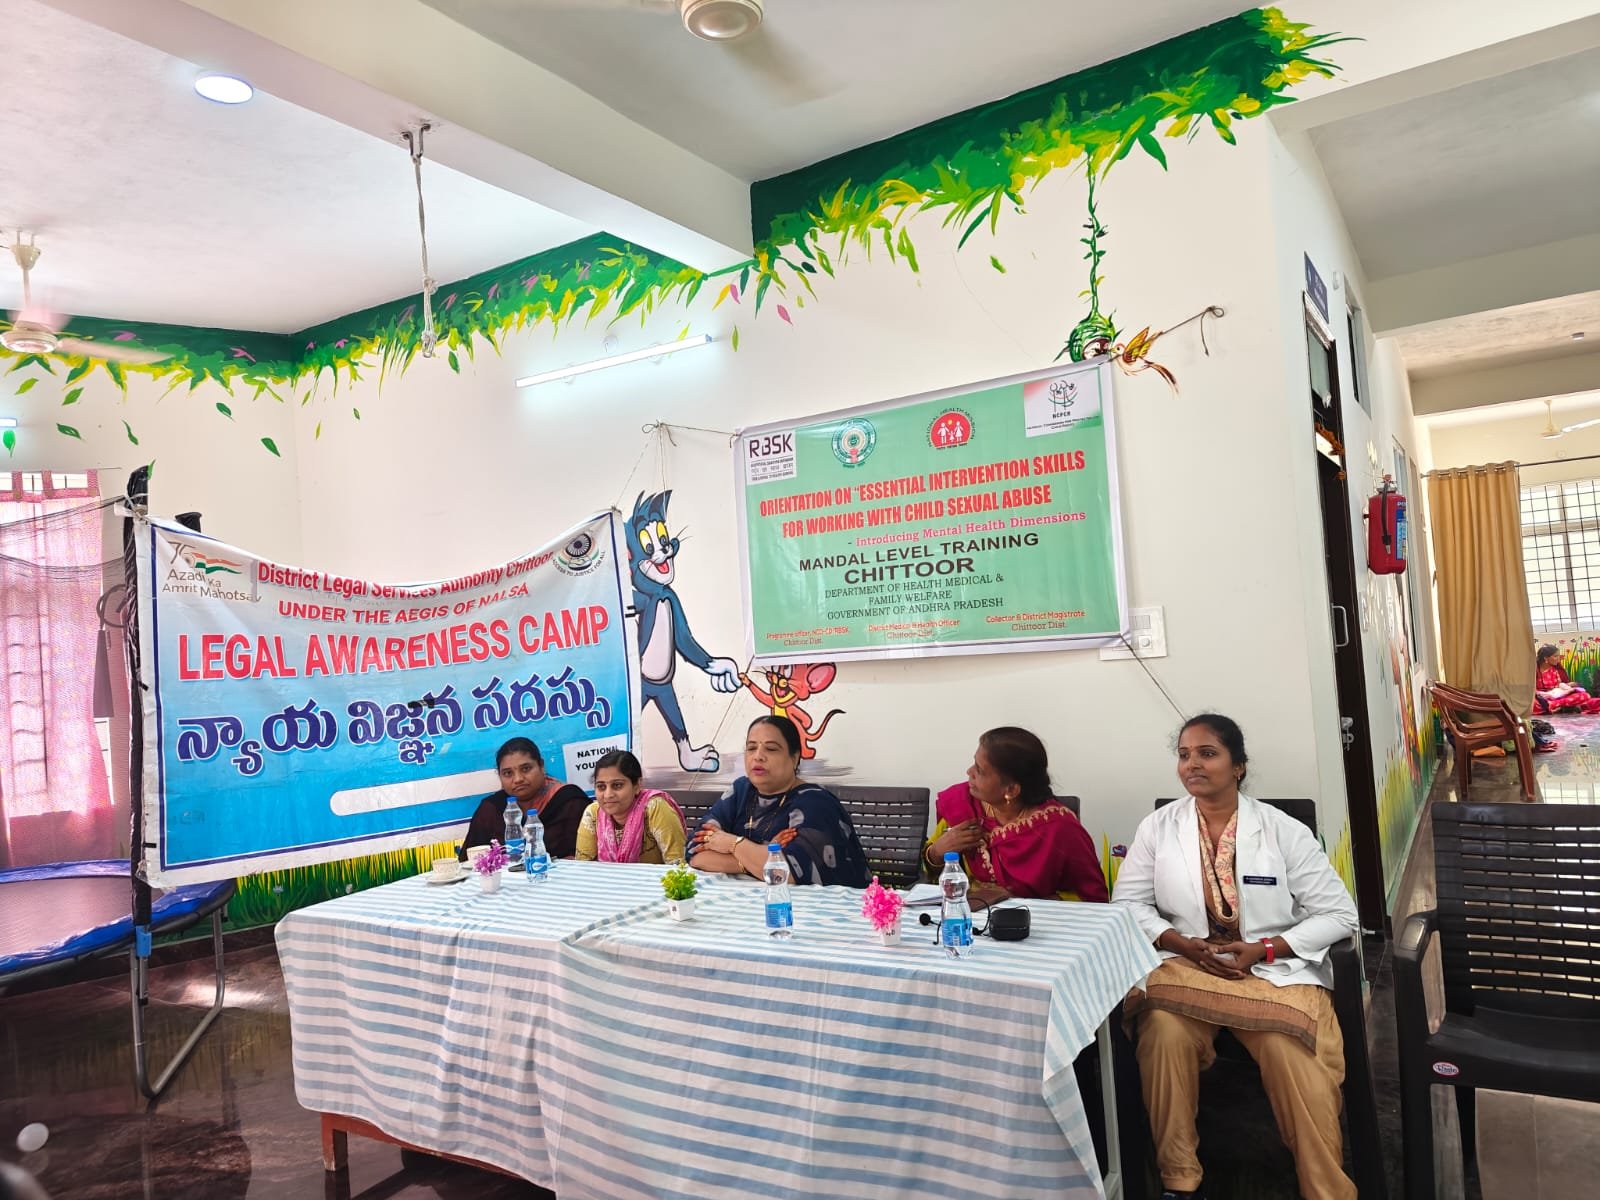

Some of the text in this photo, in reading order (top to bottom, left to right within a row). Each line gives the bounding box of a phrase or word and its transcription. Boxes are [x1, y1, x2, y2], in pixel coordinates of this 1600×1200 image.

[749, 433, 793, 458] RBSK
[760, 489, 832, 517] ORIENTATION
[834, 486, 852, 506] ON
[929, 458, 1030, 491] INTERVENTION
[1033, 450, 1086, 476] SKILLS
[783, 484, 1052, 538] FOR WORKING WITH CHILD SEXUAL ABUSE
[856, 531, 920, 547] Introducing
[923, 525, 962, 538] Mental
[965, 519, 1005, 533] Health
[1010, 512, 1086, 528] Dimensions
[800, 533, 1039, 571] MANDAL LEVEL TRAINING
[168, 568, 206, 582] Azadi
[258, 562, 319, 591] District
[323, 573, 367, 599] Legal
[505, 551, 554, 579] Chittoor
[844, 557, 976, 585] CHITTOOR
[162, 583, 198, 594] Amrit
[825, 573, 1005, 599] DEPARTMENT OF HEALTH MEDICAL &
[868, 591, 953, 606] FAMILY WELFARE
[279, 583, 529, 624] UNDER THE AEGIS OF NALSA
[827, 597, 1003, 620] GOVERNMENT OF ANDHRA PRADESH
[1022, 612, 1046, 621] District
[1047, 610, 1085, 620] Magistrate
[1011, 623, 1046, 632] Chittoor
[178, 605, 610, 680] LEGAL AWARENESS CAMP
[177, 698, 338, 776] న్యాయ
[472, 666, 611, 729] సదస్సు
